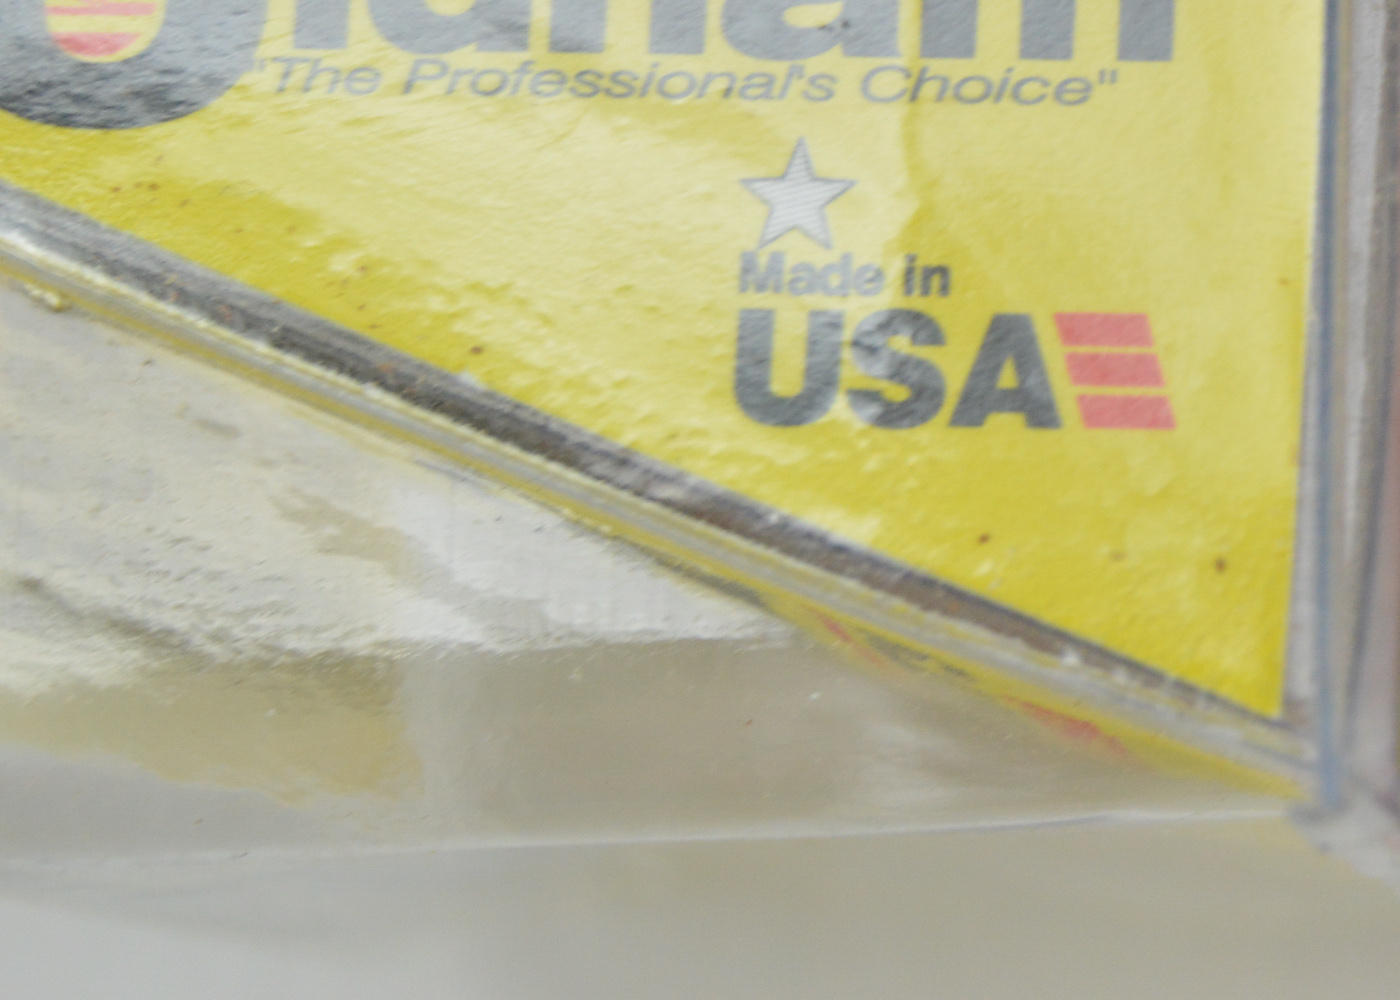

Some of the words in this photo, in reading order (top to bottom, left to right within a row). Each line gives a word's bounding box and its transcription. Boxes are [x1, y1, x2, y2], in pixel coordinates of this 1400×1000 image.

[403, 57, 839, 102] Professional's
[860, 64, 1119, 106] Choice"
[739, 250, 885, 297] Made
[903, 253, 950, 298] in
[734, 308, 1062, 429] USA
